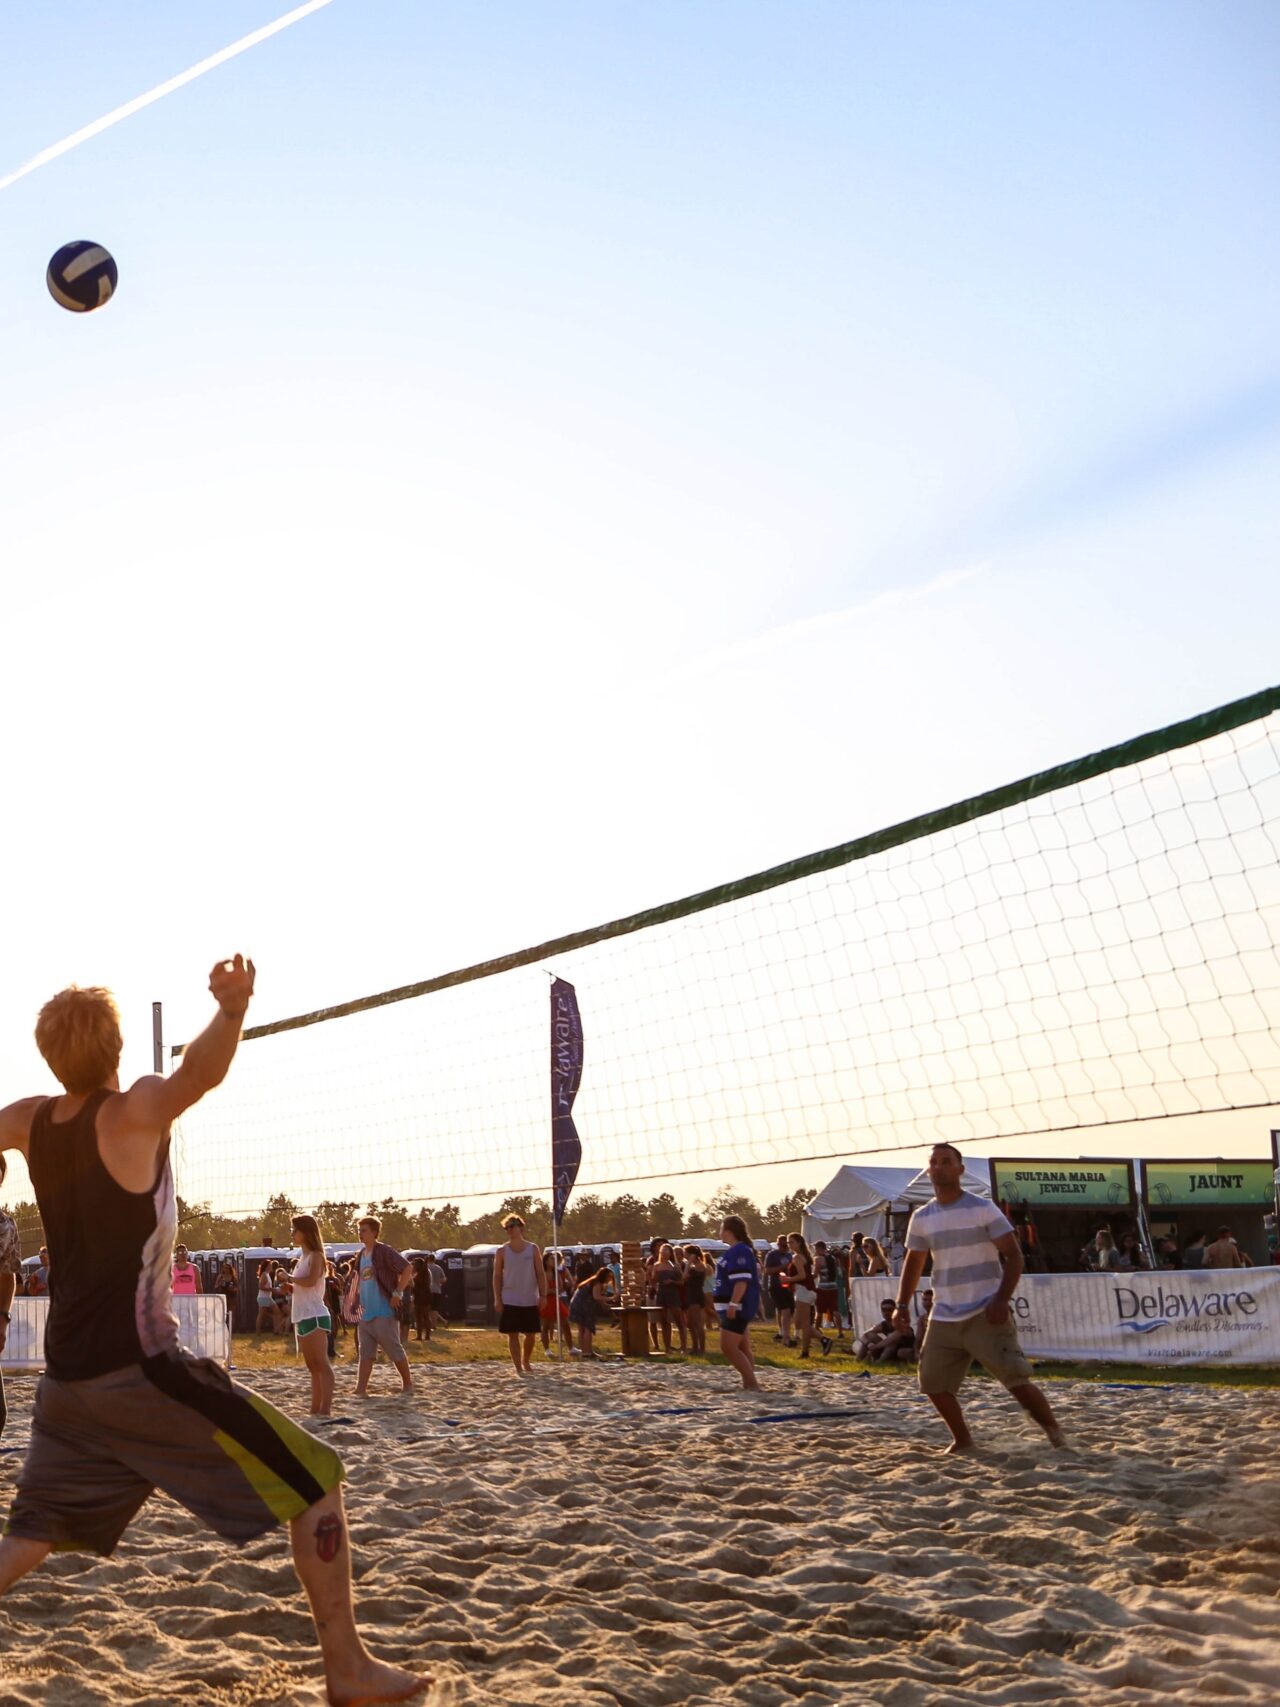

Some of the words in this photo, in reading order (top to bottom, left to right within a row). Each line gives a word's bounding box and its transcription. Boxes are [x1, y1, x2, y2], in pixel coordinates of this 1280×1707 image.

[555, 997, 570, 1106] laware
[1015, 1171, 1066, 1181] SULTANA
[1068, 1172, 1106, 1182] MARIA
[1189, 1175, 1244, 1192] JAUNT
[1039, 1183, 1087, 1195] JEWELRY
[1112, 1286, 1258, 1319] Delaware
[1176, 1319, 1212, 1333] Endless
